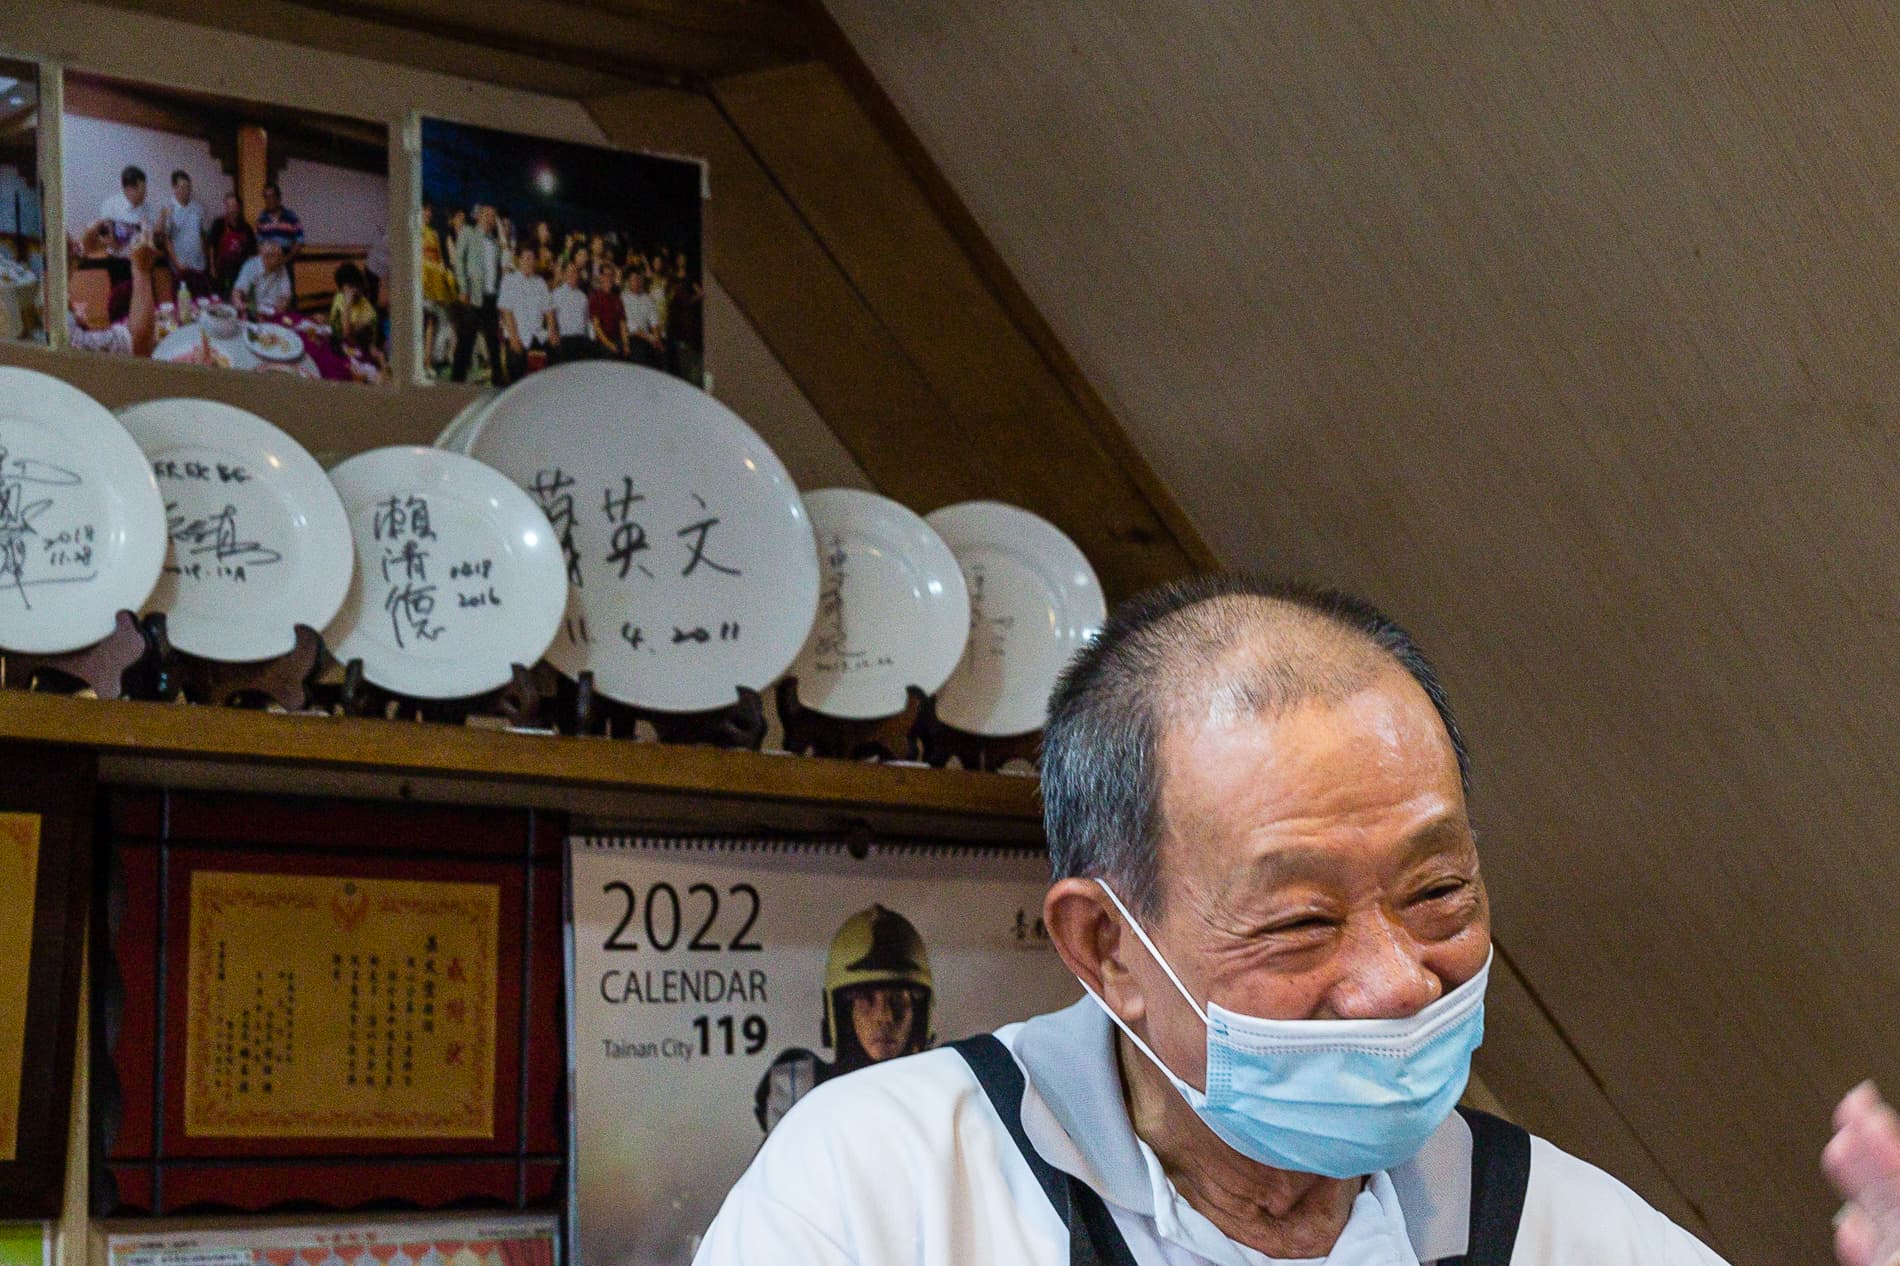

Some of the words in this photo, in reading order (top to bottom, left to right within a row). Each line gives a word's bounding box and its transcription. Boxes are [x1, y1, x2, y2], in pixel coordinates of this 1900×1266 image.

[457, 586, 501, 608] 2016
[671, 621, 740, 645] 2011
[602, 880, 763, 951] 2022
[601, 969, 768, 1003] CALENDAR
[603, 1038, 658, 1058] Tainan
[661, 1038, 694, 1061] City
[693, 1014, 768, 1056] 119
